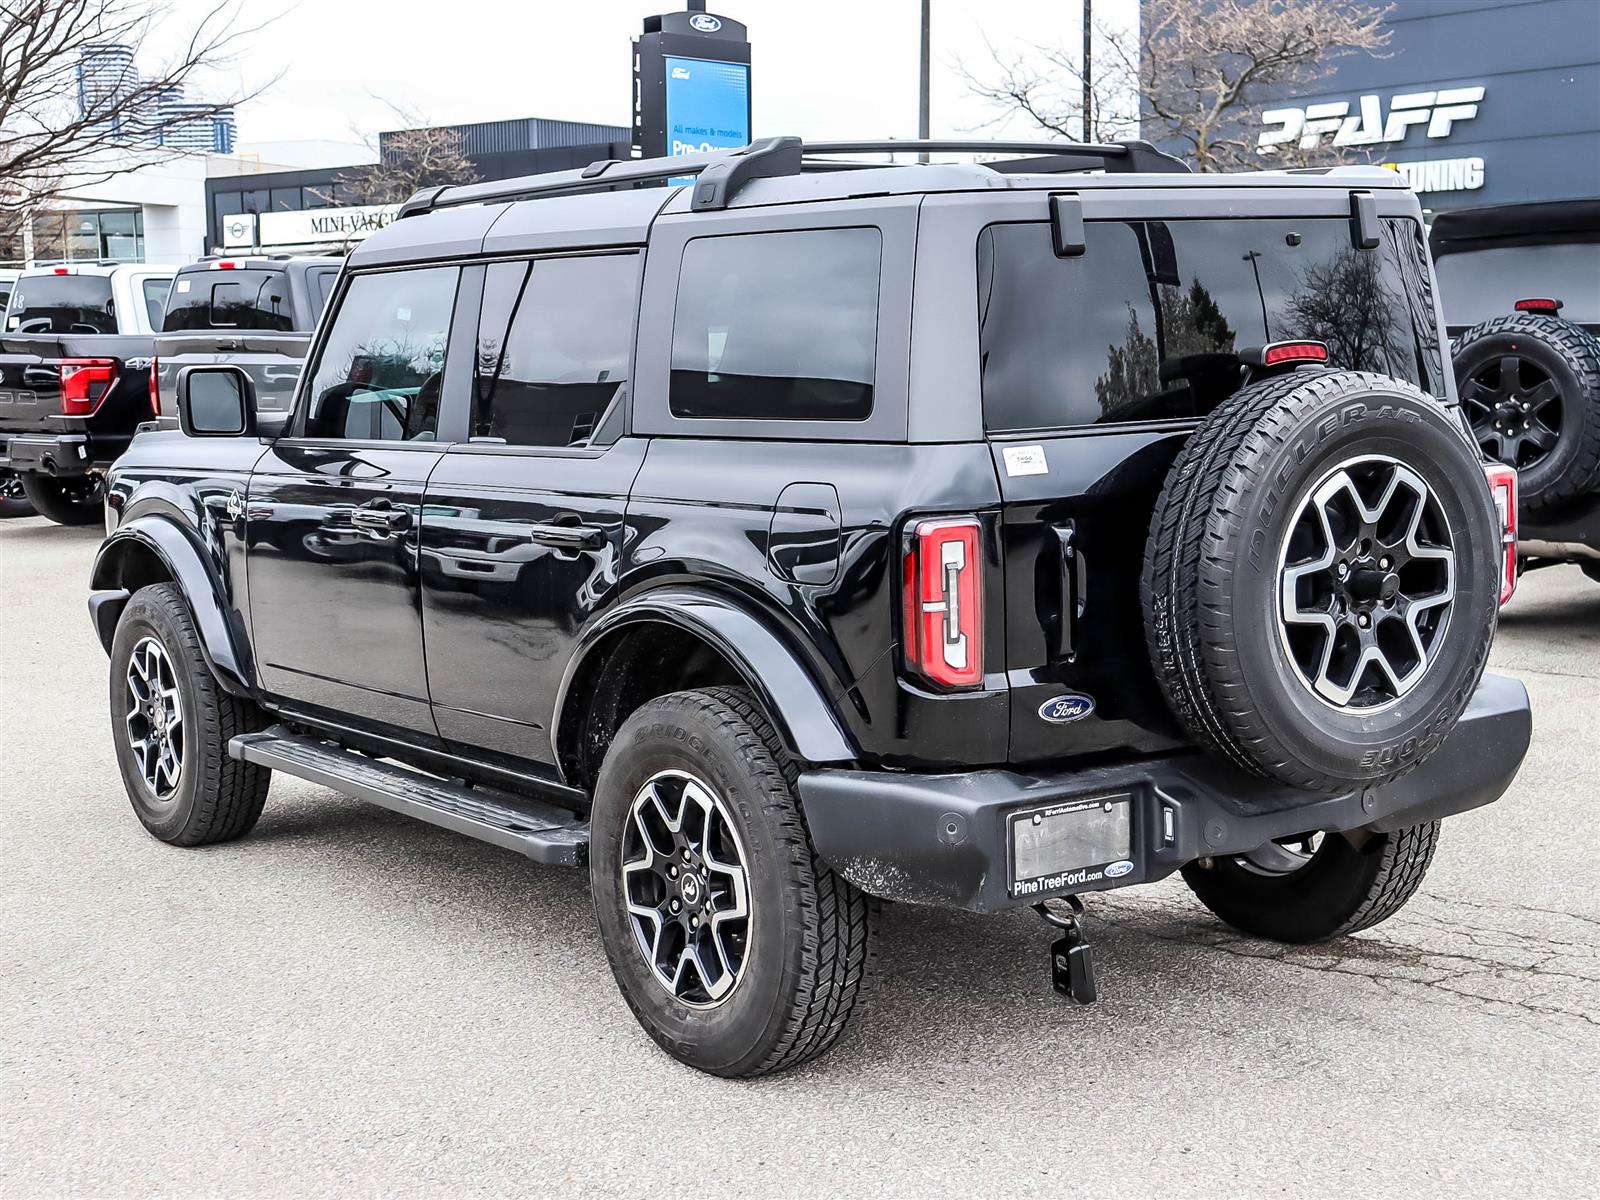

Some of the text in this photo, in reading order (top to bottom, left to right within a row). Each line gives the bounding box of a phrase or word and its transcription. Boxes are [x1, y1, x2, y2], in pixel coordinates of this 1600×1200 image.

[673, 125, 742, 139] All makes & models
[1256, 86, 1486, 155] PFAFF
[1398, 157, 1485, 193] TUNING
[311, 216, 346, 235] MINI
[1052, 701, 1083, 718] Ford
[1014, 869, 1103, 896] PineTreeFord.com
